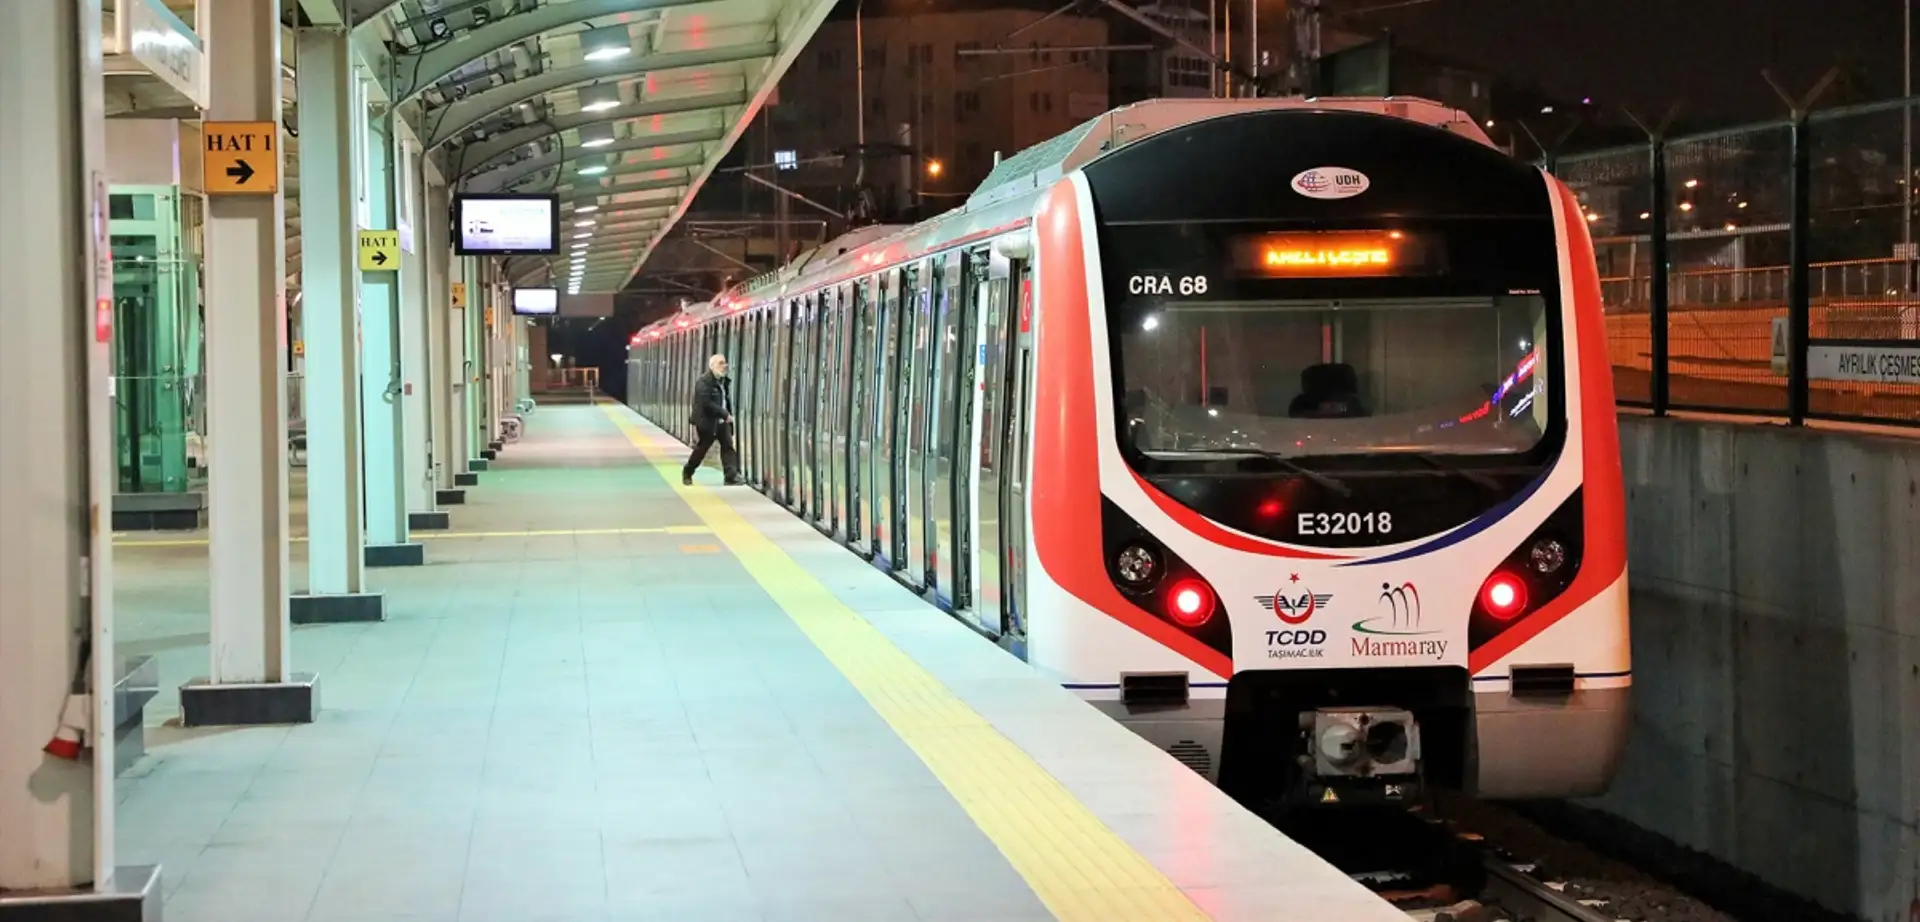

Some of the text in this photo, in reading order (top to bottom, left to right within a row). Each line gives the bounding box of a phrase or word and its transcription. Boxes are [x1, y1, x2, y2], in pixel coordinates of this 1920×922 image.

[207, 134, 271, 151] HAT 1
[1335, 174, 1361, 186] UDH
[360, 237, 397, 247] HAT 1
[1129, 275, 1208, 296] CRA 68
[1838, 353, 1877, 375] AYRILIK
[1297, 512, 1392, 535] E32018
[1265, 629, 1327, 646] TCDD
[1350, 636, 1448, 660] Marmaray
